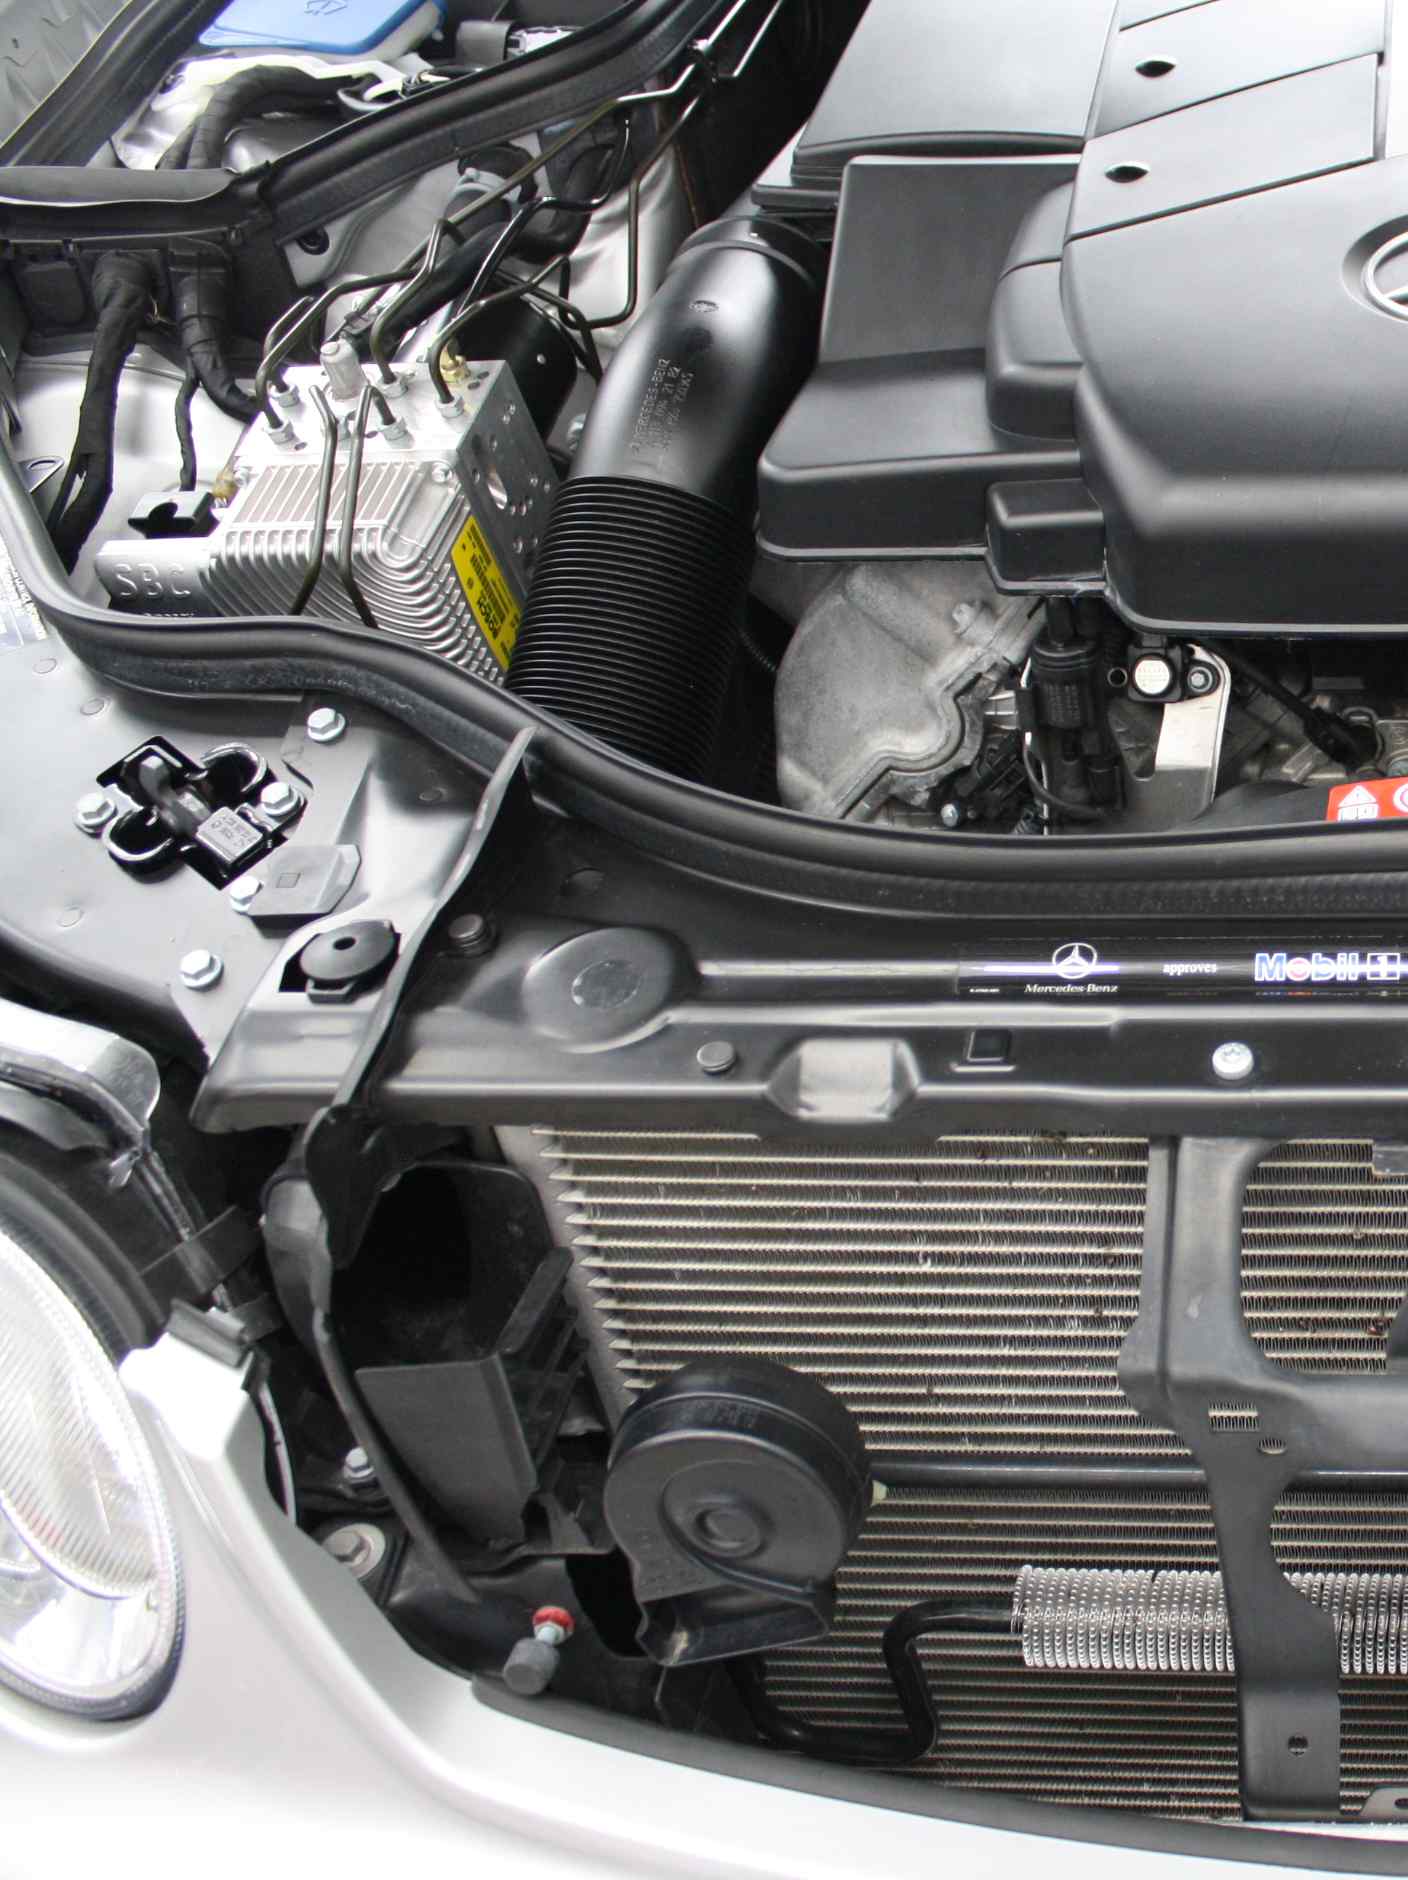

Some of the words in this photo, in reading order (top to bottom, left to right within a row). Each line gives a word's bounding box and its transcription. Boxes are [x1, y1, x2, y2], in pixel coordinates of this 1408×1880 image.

[113, 562, 191, 597] SBC
[1163, 963, 1217, 976] approves
[1254, 952, 1359, 981] Mobil
[1024, 983, 1118, 994] Mercedes-Benz
